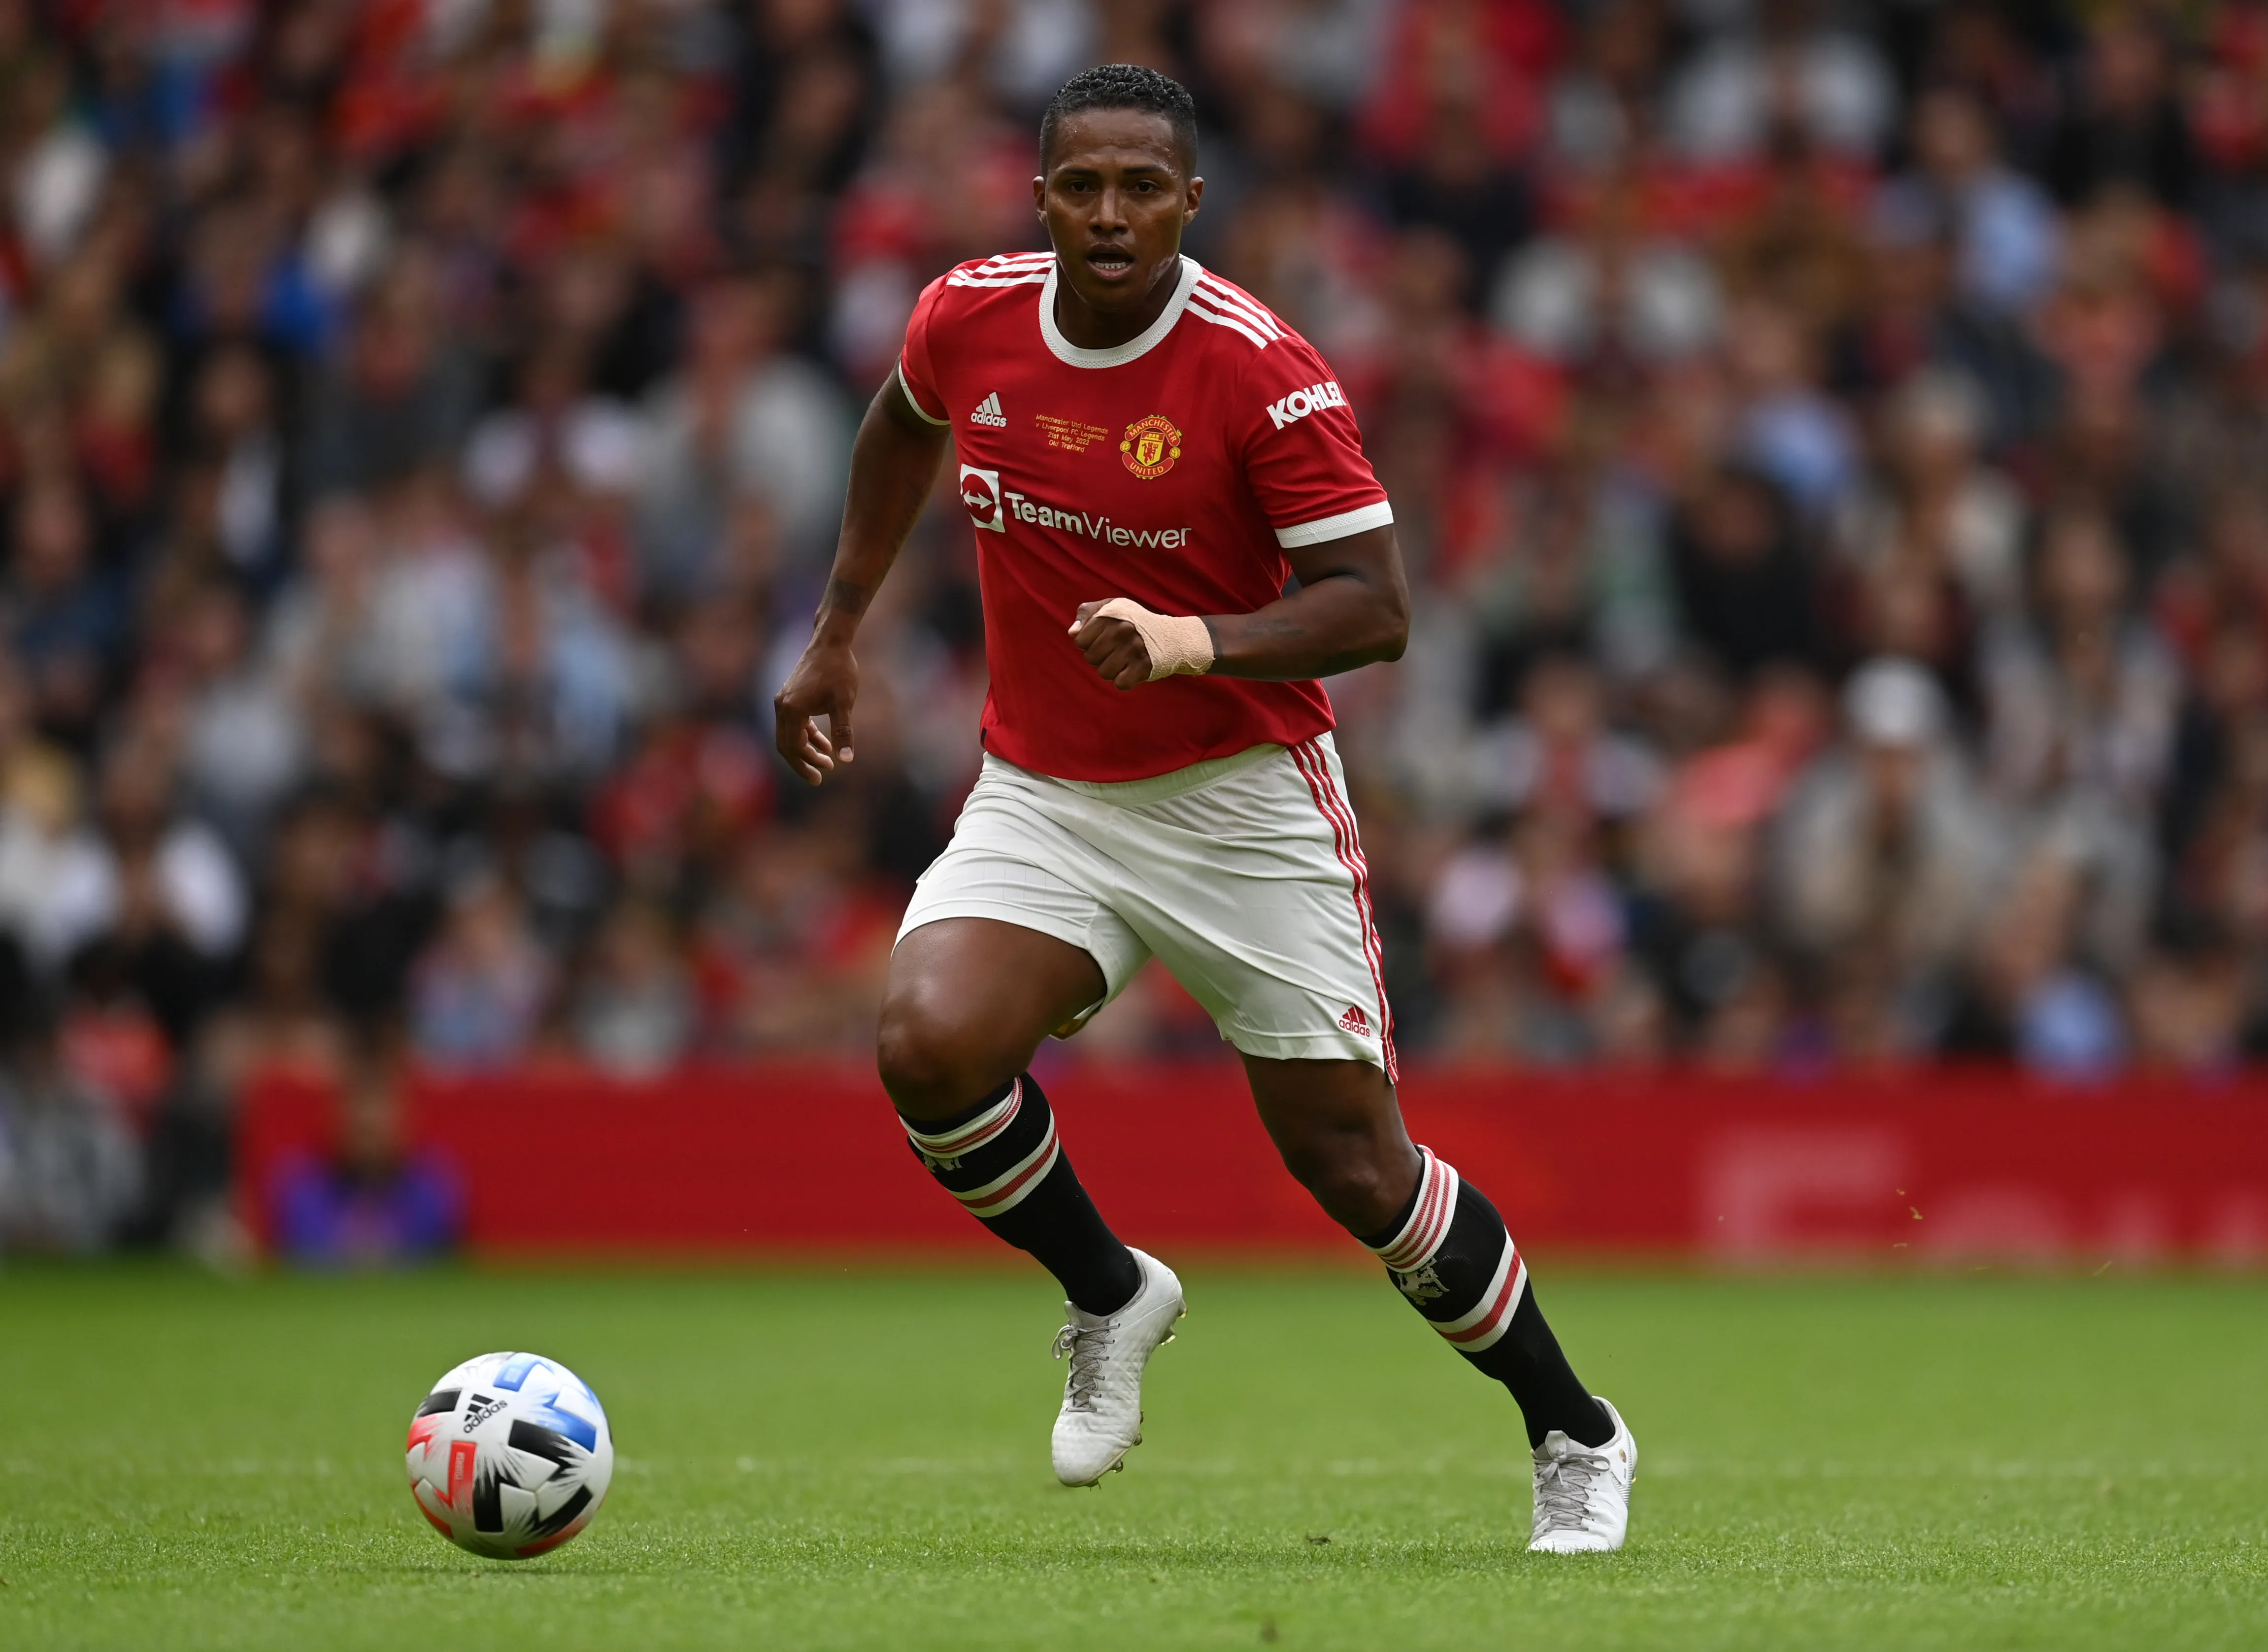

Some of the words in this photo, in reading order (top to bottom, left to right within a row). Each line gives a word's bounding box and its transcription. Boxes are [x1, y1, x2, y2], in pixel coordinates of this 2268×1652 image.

[1266, 381, 1347, 430] KOHLER
[971, 411, 1007, 428] adidas
[1035, 414, 1069, 425] Manchester
[1084, 424, 1108, 435] Legends
[1042, 423, 1069, 433] Liverpool
[1081, 431, 1105, 441] Legends
[1061, 435, 1073, 443] May
[1129, 419, 1177, 442] MANCHESTER
[1061, 442, 1085, 453] Trafford
[1130, 462, 1164, 475] UNITED
[1004, 491, 1192, 549] TeamViewer
[1339, 1019, 1370, 1037] adidas
[463, 1400, 507, 1434] adidas
